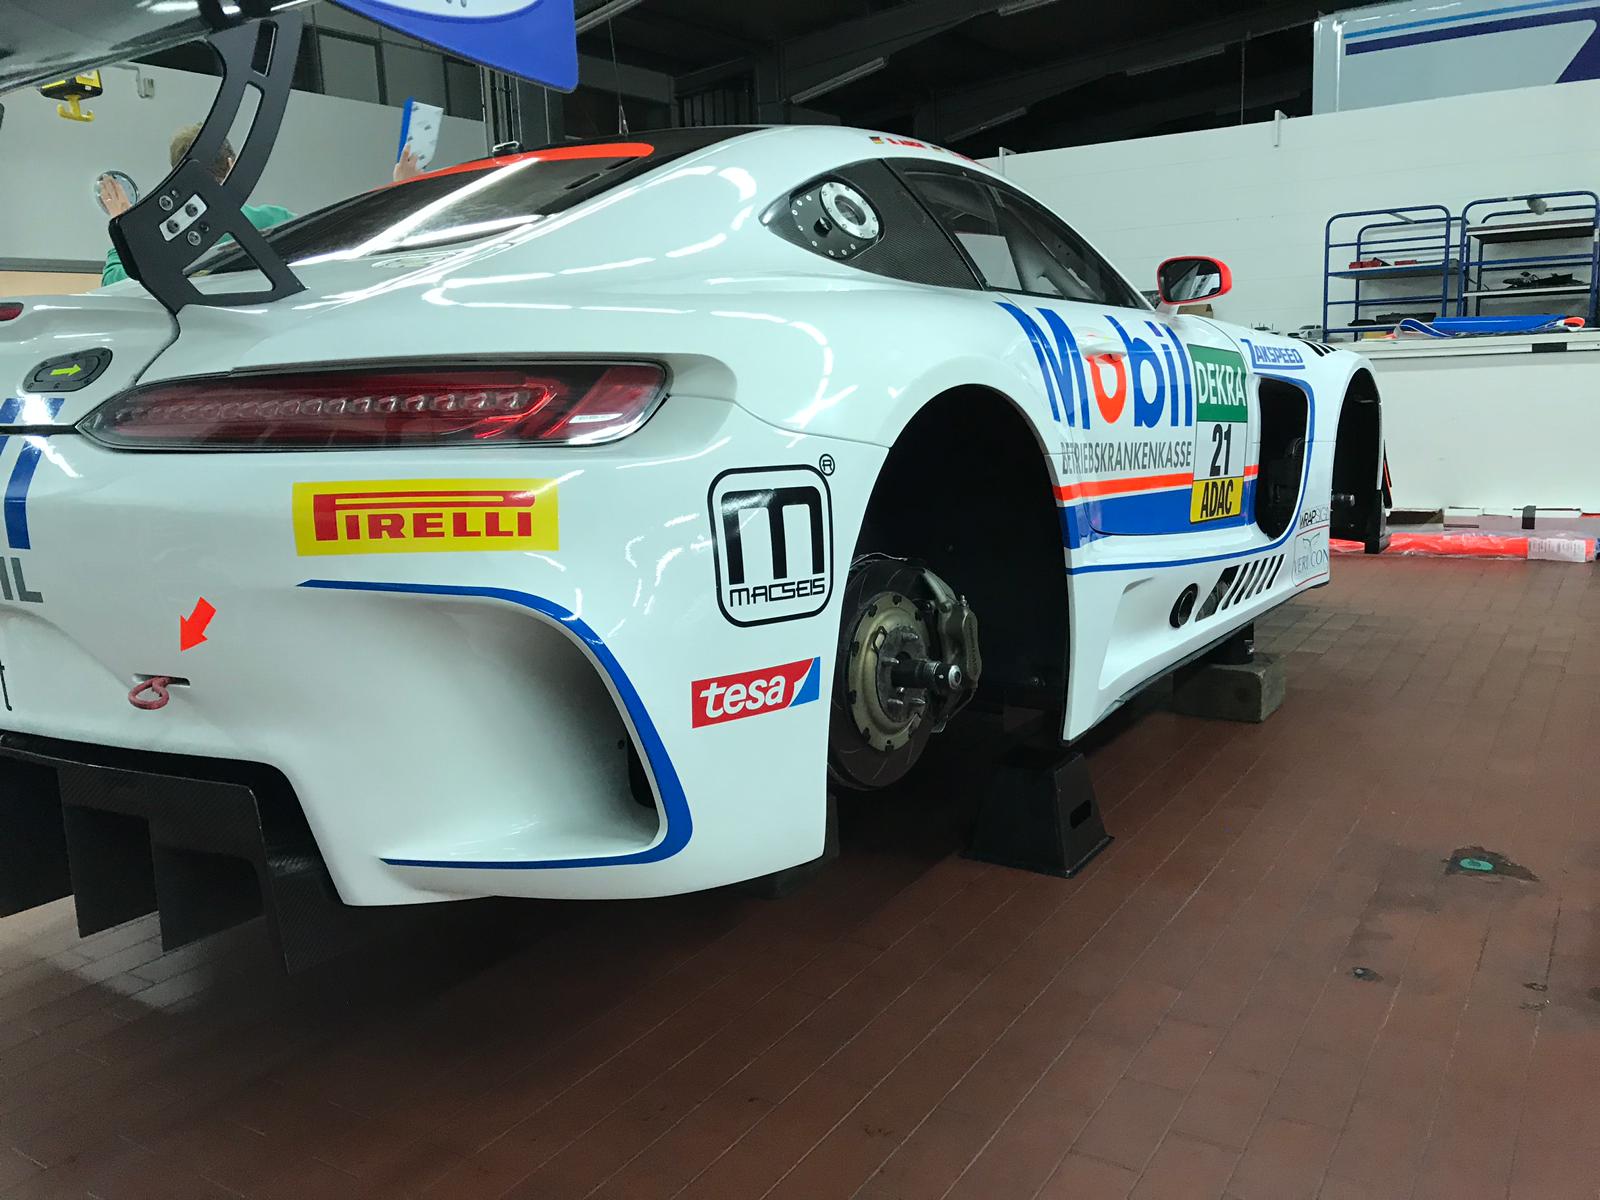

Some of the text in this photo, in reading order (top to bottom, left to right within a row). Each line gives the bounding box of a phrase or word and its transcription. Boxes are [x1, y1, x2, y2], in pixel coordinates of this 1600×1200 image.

[995, 302, 1193, 430] Mobil
[1240, 338, 1305, 369] ZAKSPEED
[1195, 360, 1247, 407] DEKRA
[1060, 441, 1192, 475] BETRIEBSKRANKENKASSE
[1209, 423, 1232, 477] 21
[313, 490, 536, 541] PIRELLI
[1200, 479, 1233, 519] ADAC
[730, 577, 825, 607] MACSEIS
[700, 675, 786, 718] tesa
